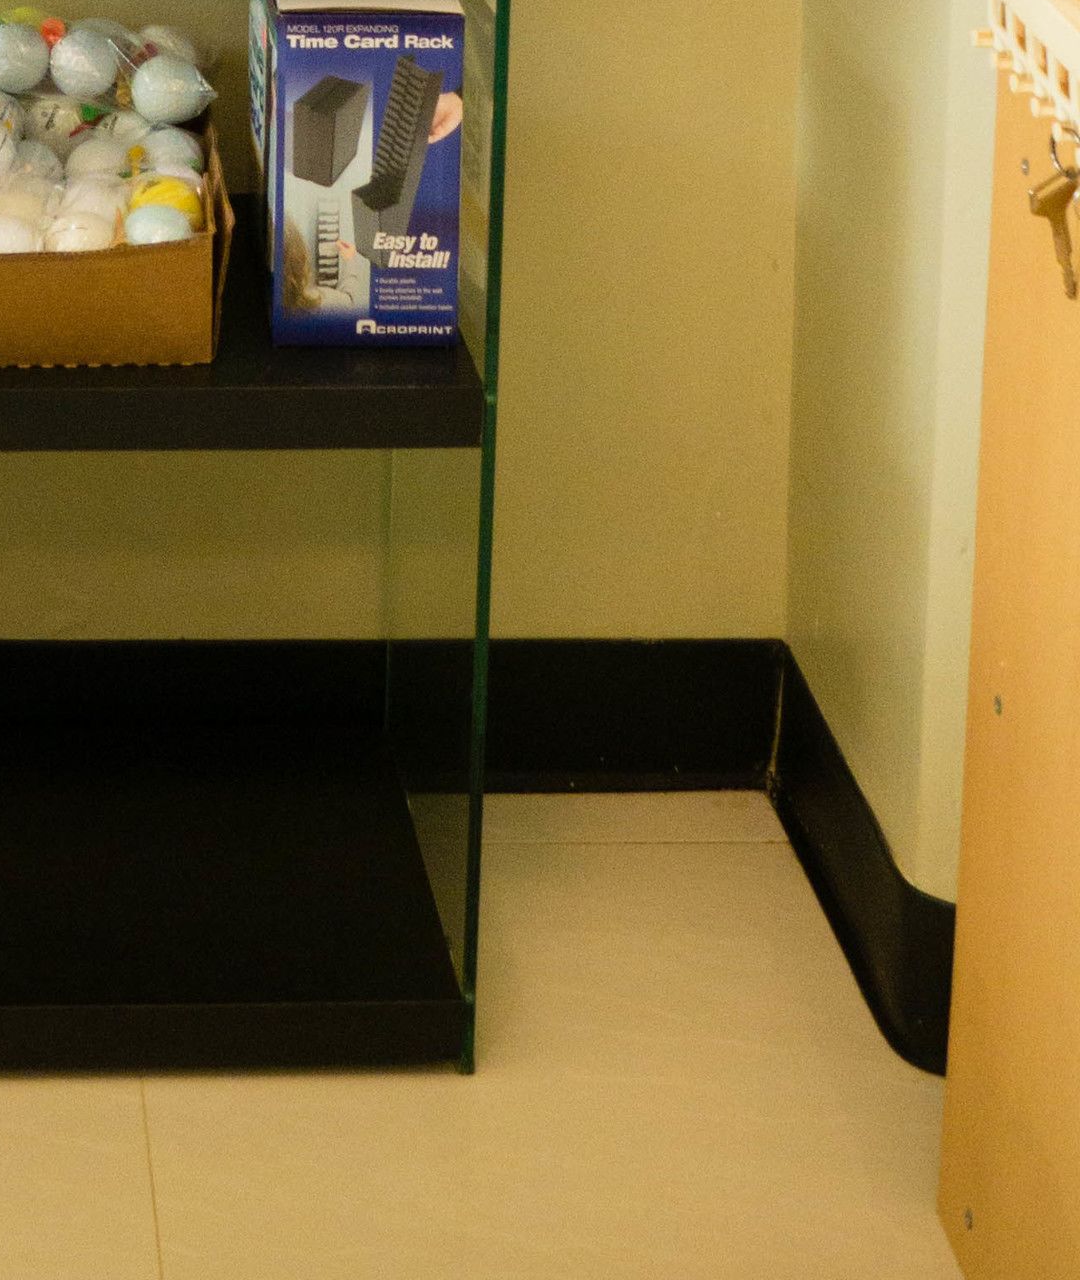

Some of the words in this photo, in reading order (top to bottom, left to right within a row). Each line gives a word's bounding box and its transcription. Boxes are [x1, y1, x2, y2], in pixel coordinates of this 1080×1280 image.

[287, 23, 321, 34] MODEL
[346, 23, 400, 34] EXPANDING
[286, 34, 339, 49] Time
[343, 34, 400, 49] Card
[404, 34, 454, 49] Rack
[373, 231, 418, 255] Easy
[419, 232, 439, 251] to
[388, 250, 451, 269] Install!
